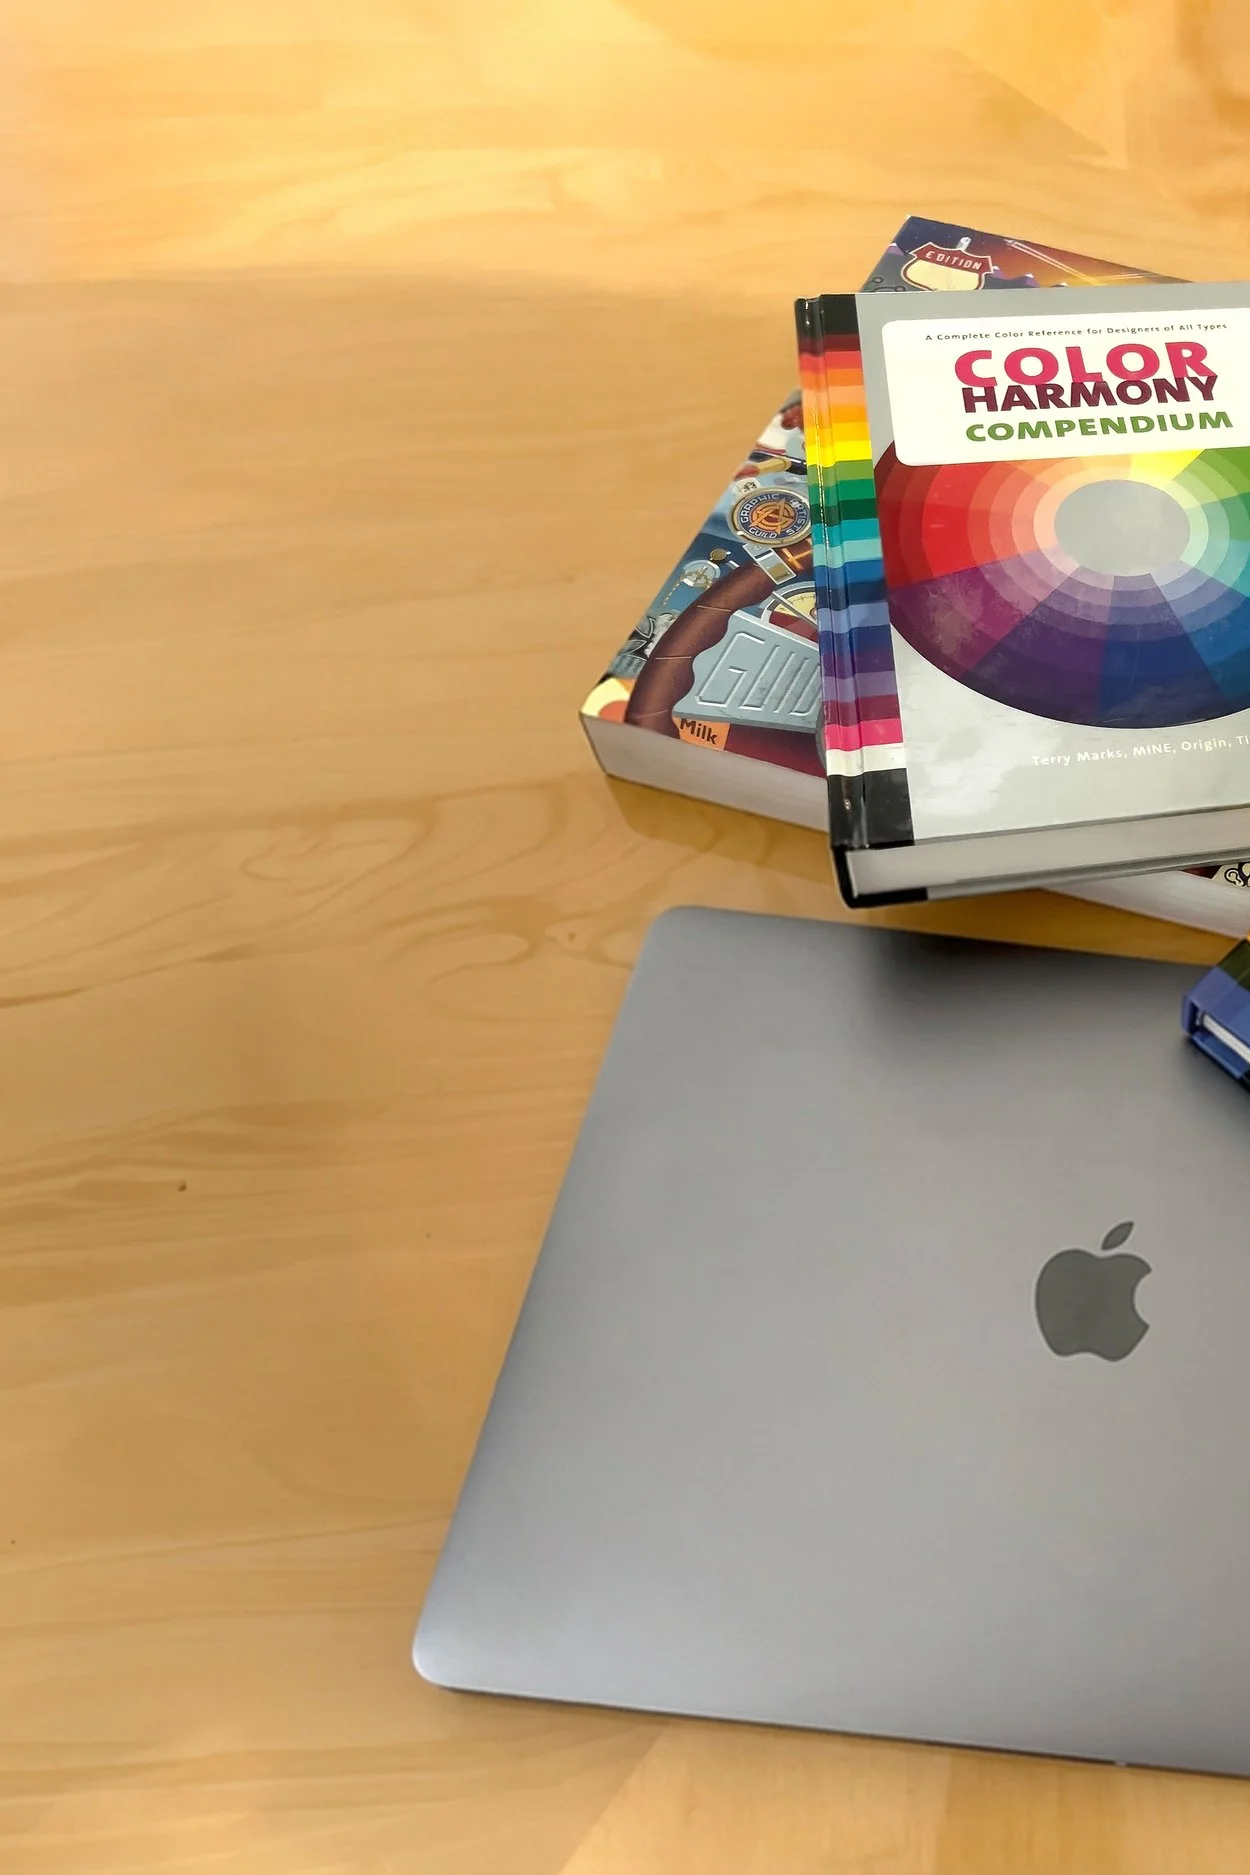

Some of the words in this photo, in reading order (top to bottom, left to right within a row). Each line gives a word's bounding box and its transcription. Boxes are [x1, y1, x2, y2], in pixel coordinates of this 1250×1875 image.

[925, 250, 982, 270] EDITION
[937, 332, 990, 341] Complete
[1107, 327, 1160, 335] Designers
[1197, 323, 1228, 331] Types
[954, 341, 1218, 387] COLOR
[961, 375, 1218, 413] HARMONY
[965, 411, 1233, 442] COMPENDIUM
[740, 493, 781, 523] GRAPHIC
[749, 525, 777, 539] GUILD
[679, 717, 717, 744] Milk
[1032, 754, 1071, 767] Terry
[1077, 749, 1128, 762] Marks,
[1133, 743, 1177, 756] MINE,
[1181, 738, 1232, 753] Origin,
